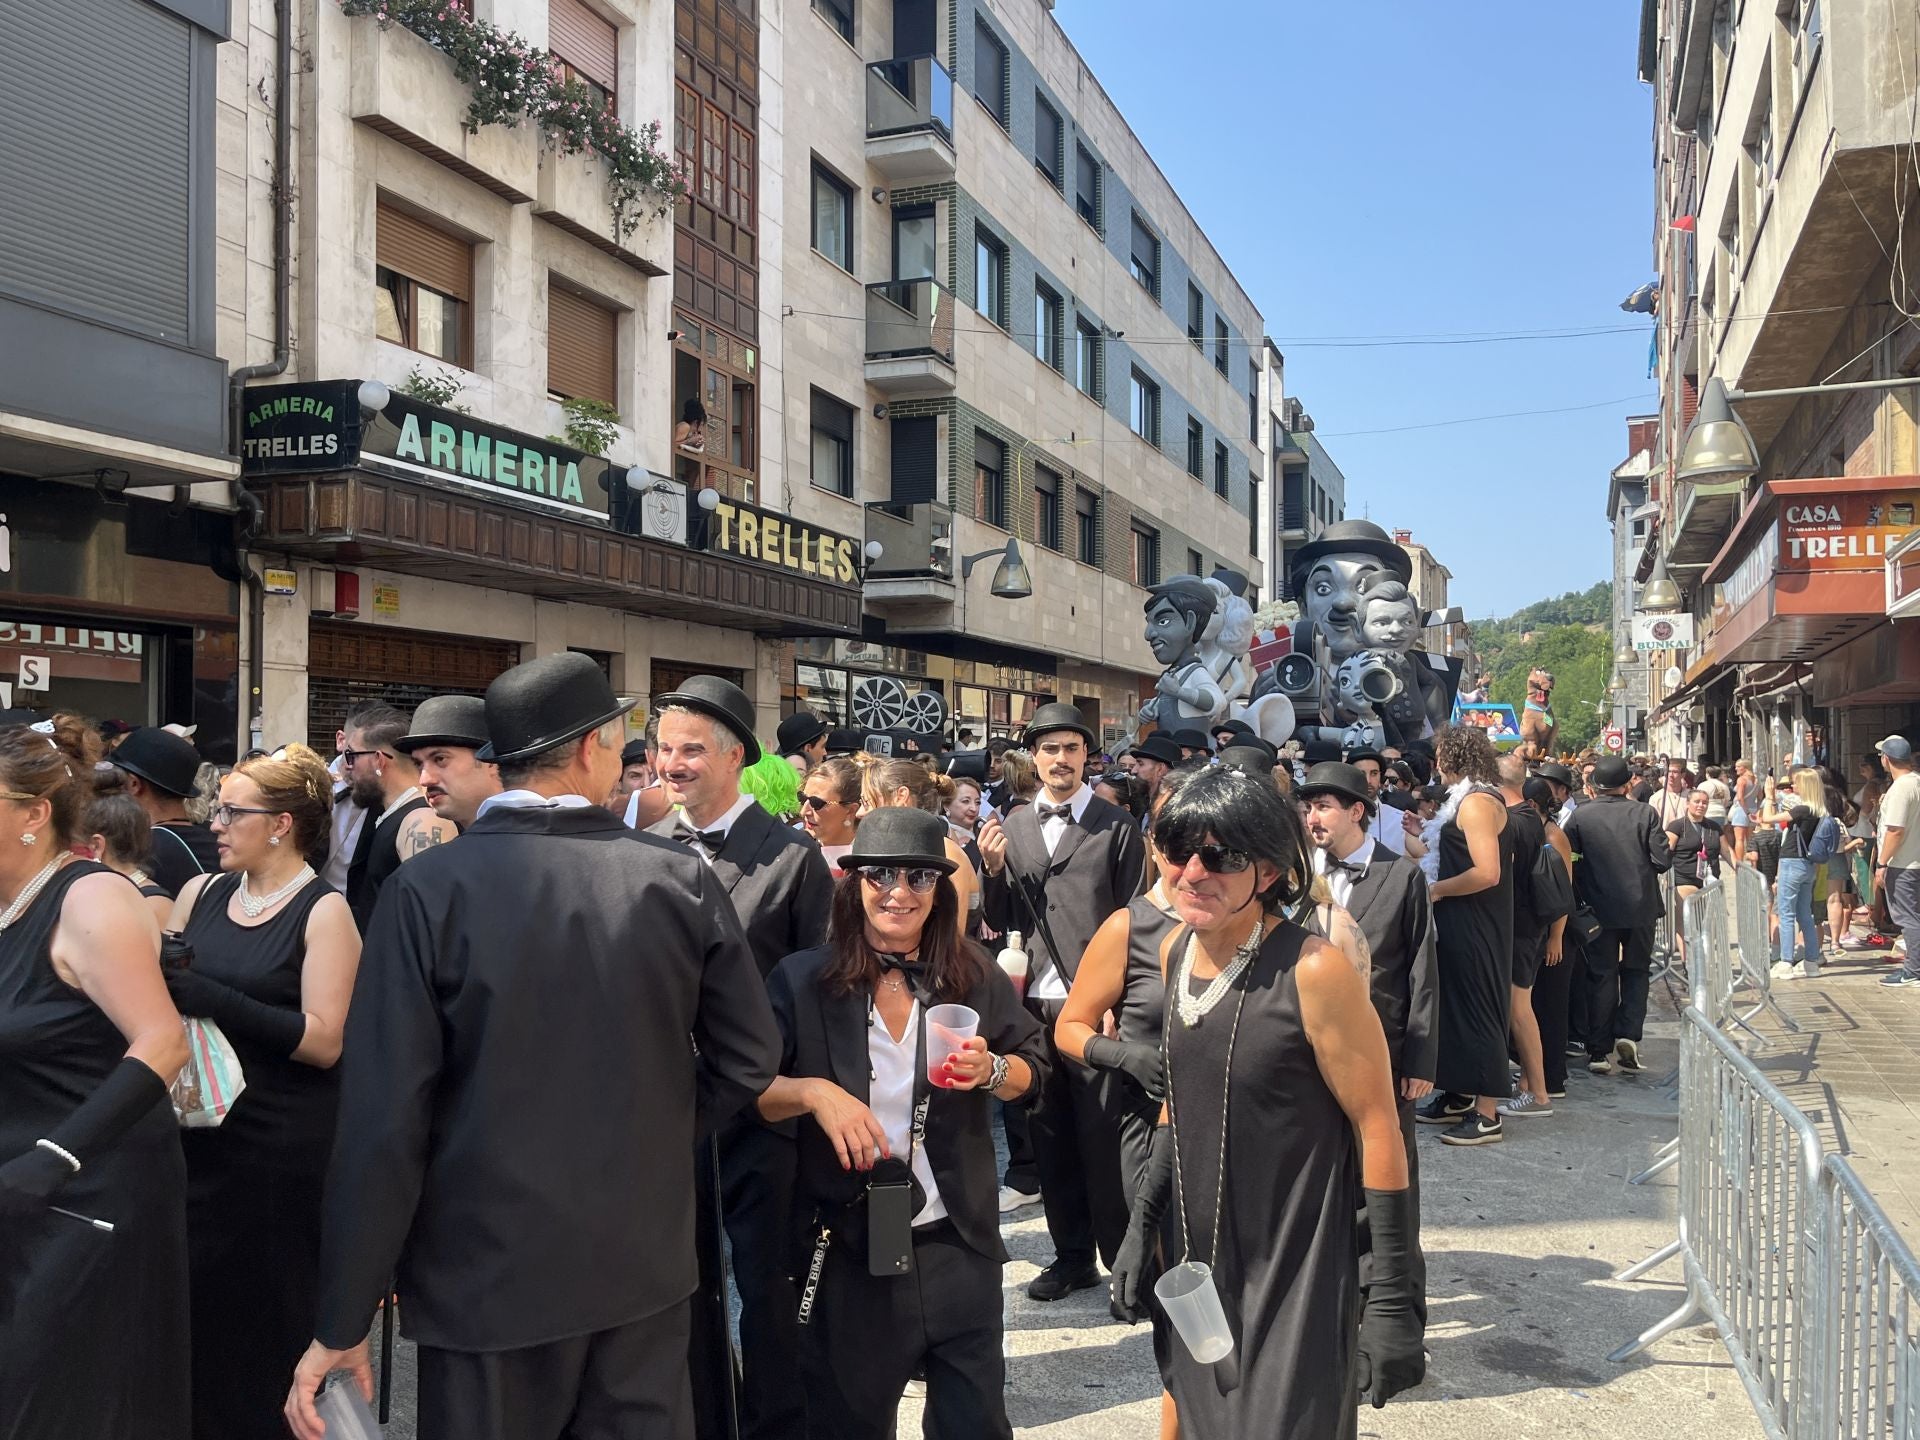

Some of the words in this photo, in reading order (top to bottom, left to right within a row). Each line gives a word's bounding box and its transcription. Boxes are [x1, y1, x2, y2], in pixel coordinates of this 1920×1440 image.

[249, 397, 334, 428] ARMERIA
[244, 433, 338, 459] TRELLES
[396, 412, 584, 504] ARMERIA
[1786, 504, 1841, 524] CASA
[715, 502, 852, 583] TRELLES
[1786, 533, 1911, 559] TRELLE
[1637, 639, 1690, 650] BUNKAI
[23, 659, 39, 686] S
[800, 1286, 815, 1317] LOLA
